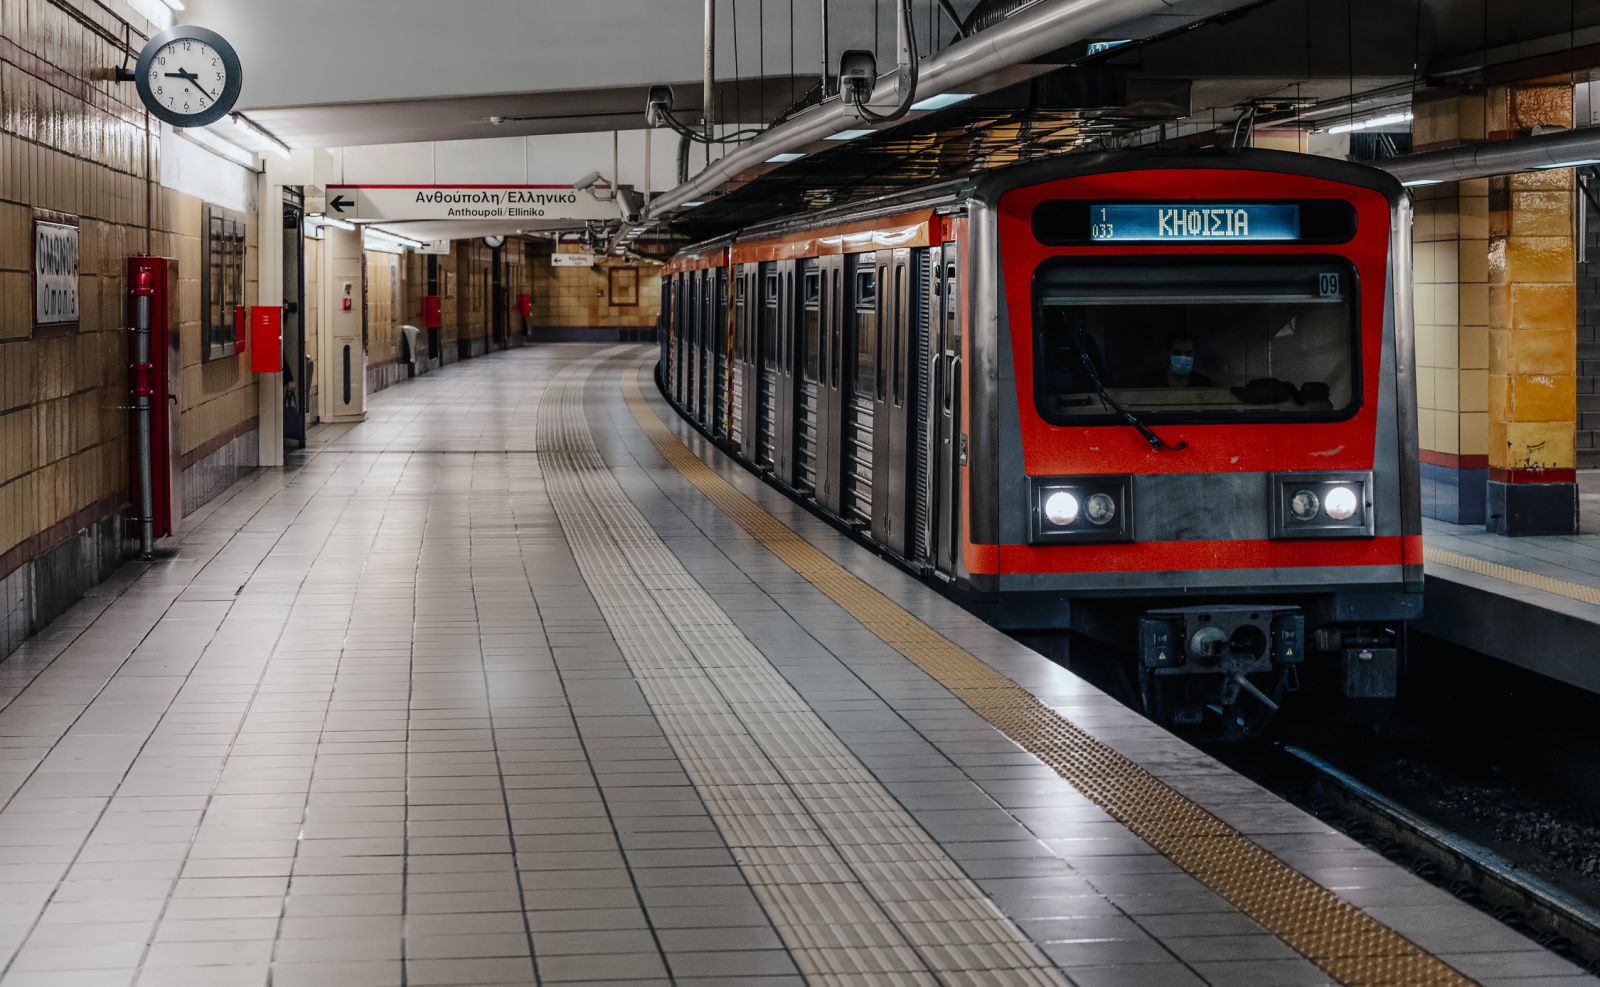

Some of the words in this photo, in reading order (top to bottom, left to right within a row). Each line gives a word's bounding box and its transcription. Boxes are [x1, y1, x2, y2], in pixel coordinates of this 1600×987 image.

[168, 46, 175, 55] 11
[183, 42, 191, 51] 12
[157, 57, 166, 66] 10
[211, 57, 217, 67] 2
[152, 71, 158, 80] 9
[215, 72, 221, 81] 3
[156, 86, 163, 95] 8
[210, 88, 216, 96] 4
[169, 97, 174, 106] 7
[183, 101, 190, 110] 6
[199, 98, 205, 106] 5
[415, 190, 577, 206] Ανθούπολη/Ελληνικό
[447, 207, 545, 218] Anthoupoli/Elliniko
[1100, 207, 1106, 222] 1
[1158, 209, 1249, 236] ΚΗΦΙΣΙΑ
[1092, 224, 1114, 239] 033
[1320, 274, 1338, 295] 09
[44, 282, 75, 316] Omonia
